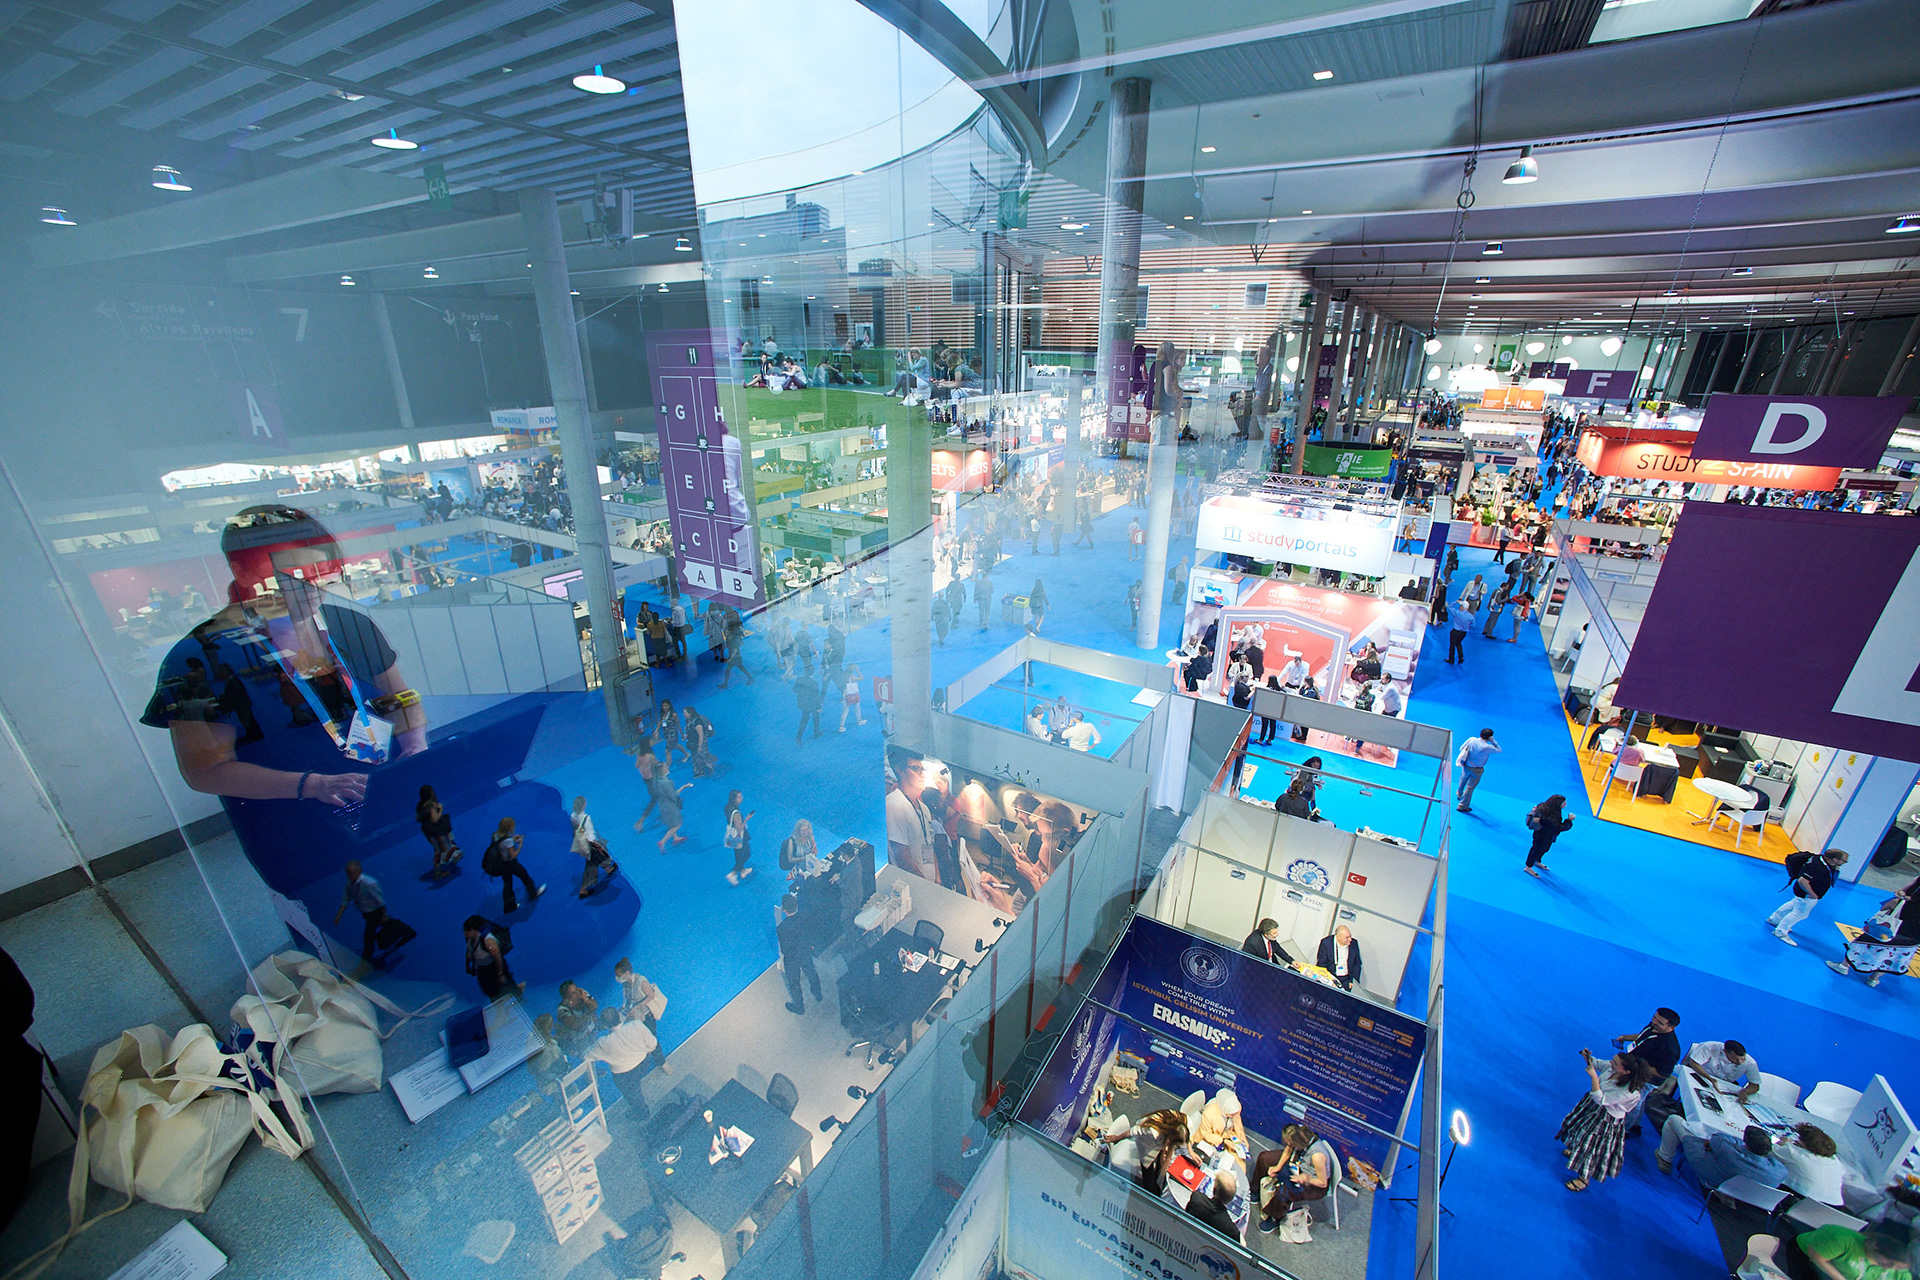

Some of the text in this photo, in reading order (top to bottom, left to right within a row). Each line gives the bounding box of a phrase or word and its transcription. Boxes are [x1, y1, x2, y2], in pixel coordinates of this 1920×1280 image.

[282, 308, 308, 341] 7
[1586, 372, 1612, 394] F
[246, 388, 273, 438] A
[497, 416, 522, 425] ROMANIA
[675, 404, 725, 422] G H
[1750, 402, 1827, 454] D
[931, 463, 956, 477] ELTS
[1336, 453, 1363, 464] EAIE
[1636, 454, 1796, 480] STUDY SPAIN
[685, 475, 733, 494] E F
[692, 532, 738, 553] C D
[1248, 529, 1358, 558] studyportals
[697, 570, 742, 591] A B
[1133, 981, 1172, 1003] ISTANBUL
[1209, 1013, 1264, 1040] UNIVERSITY
[1161, 981, 1235, 1015] WHEN YOUR DREAMS
[1167, 989, 1228, 1018] COME TRUE WITH
[1152, 1002, 1230, 1044] ERASMUS+
[1288, 1032, 1313, 1044] AMONG
[1295, 1029, 1326, 1044] ISTANBUL
[1354, 1053, 1393, 1072] UNIVERSITY
[1171, 1060, 1187, 1070] FROM
[1189, 1066, 1204, 1078] 24
[1288, 1048, 1312, 1061] Among
[1348, 1074, 1388, 1094] Universities
[1331, 1073, 1358, 1087] category
[1293, 1082, 1367, 1120] SCIMAGO 2022
[1041, 1191, 1068, 1212] 8th
[1072, 1210, 1144, 1260] EuroAsia
[1148, 1225, 1199, 1265] WORKSHOP
[1095, 1246, 1138, 1278] Marmara
[1112, 1250, 1142, 1270] 24-26
